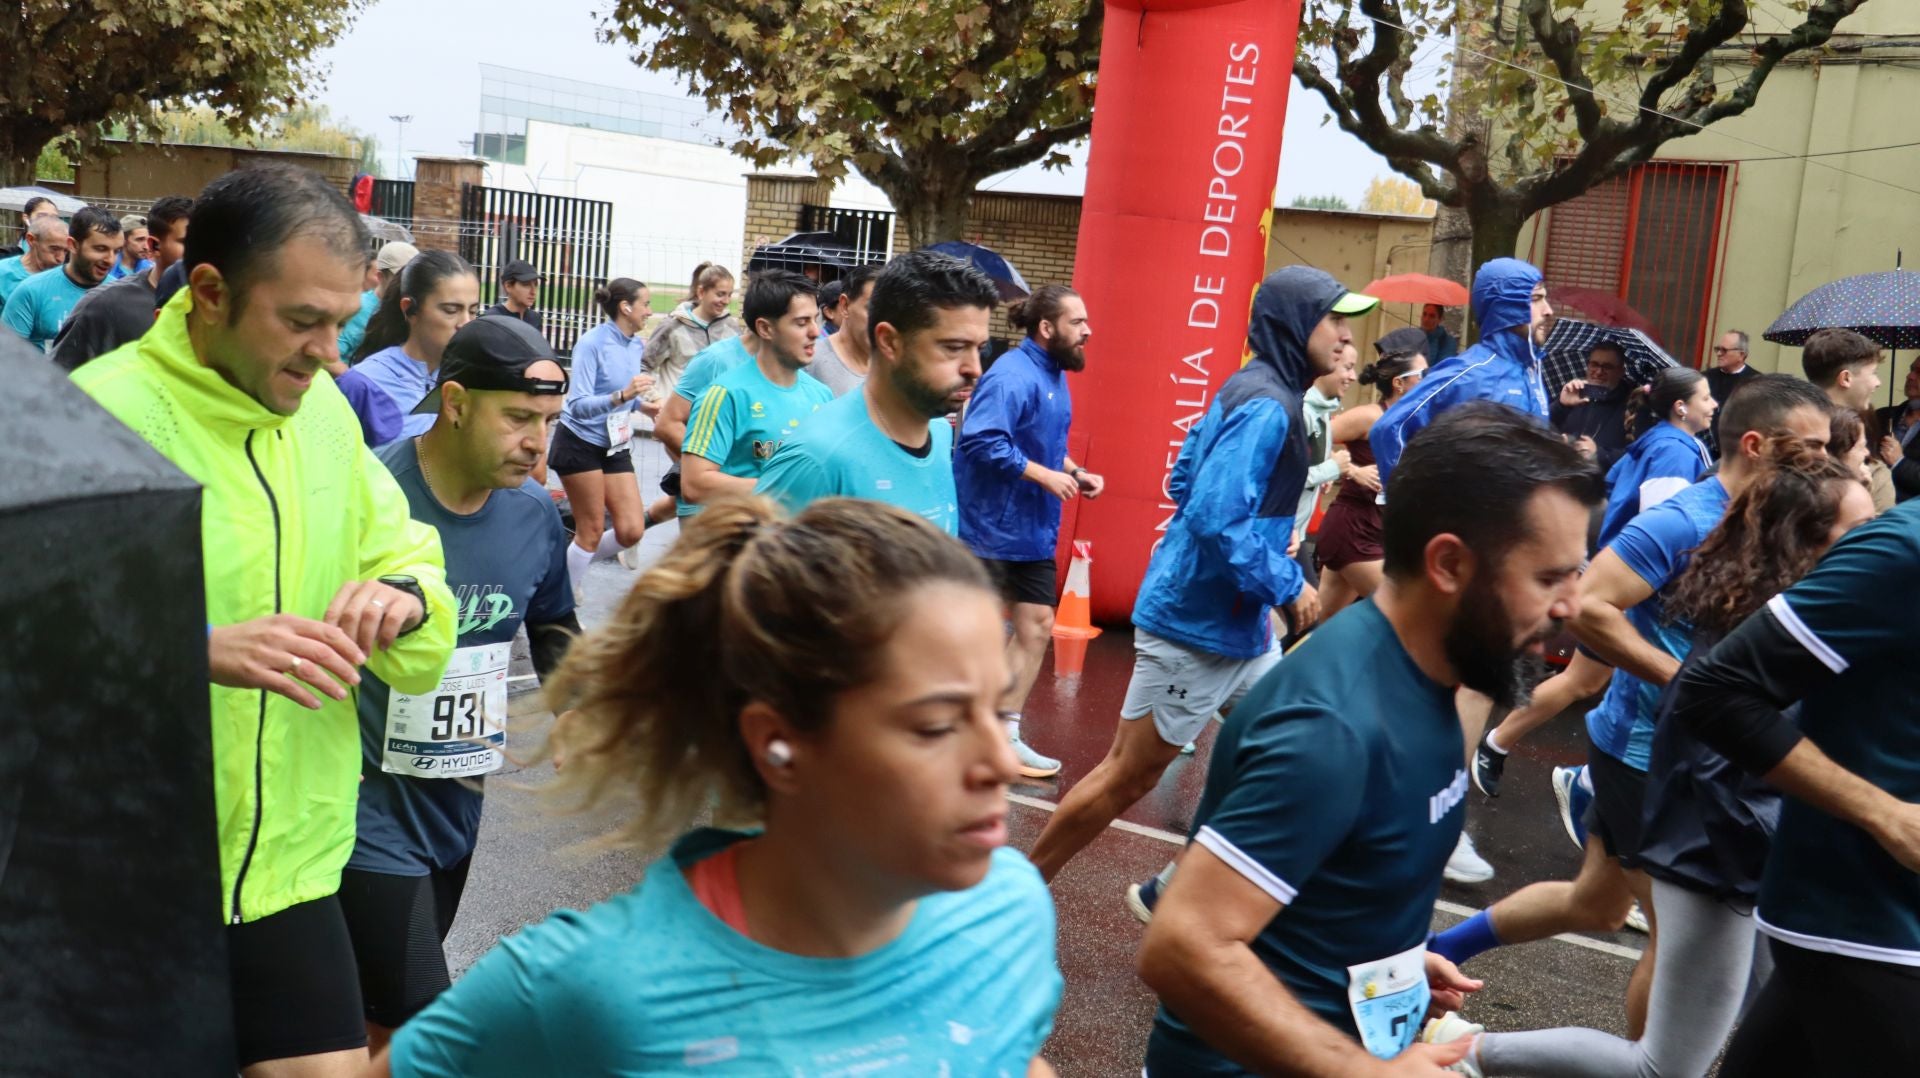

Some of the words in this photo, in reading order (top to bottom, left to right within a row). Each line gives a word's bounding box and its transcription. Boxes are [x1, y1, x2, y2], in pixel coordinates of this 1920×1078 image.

[1199, 42, 1260, 257] DEPORTES
[1188, 275, 1225, 329] DE
[431, 691, 485, 740] 931
[441, 752, 493, 768] HYUNDAI
